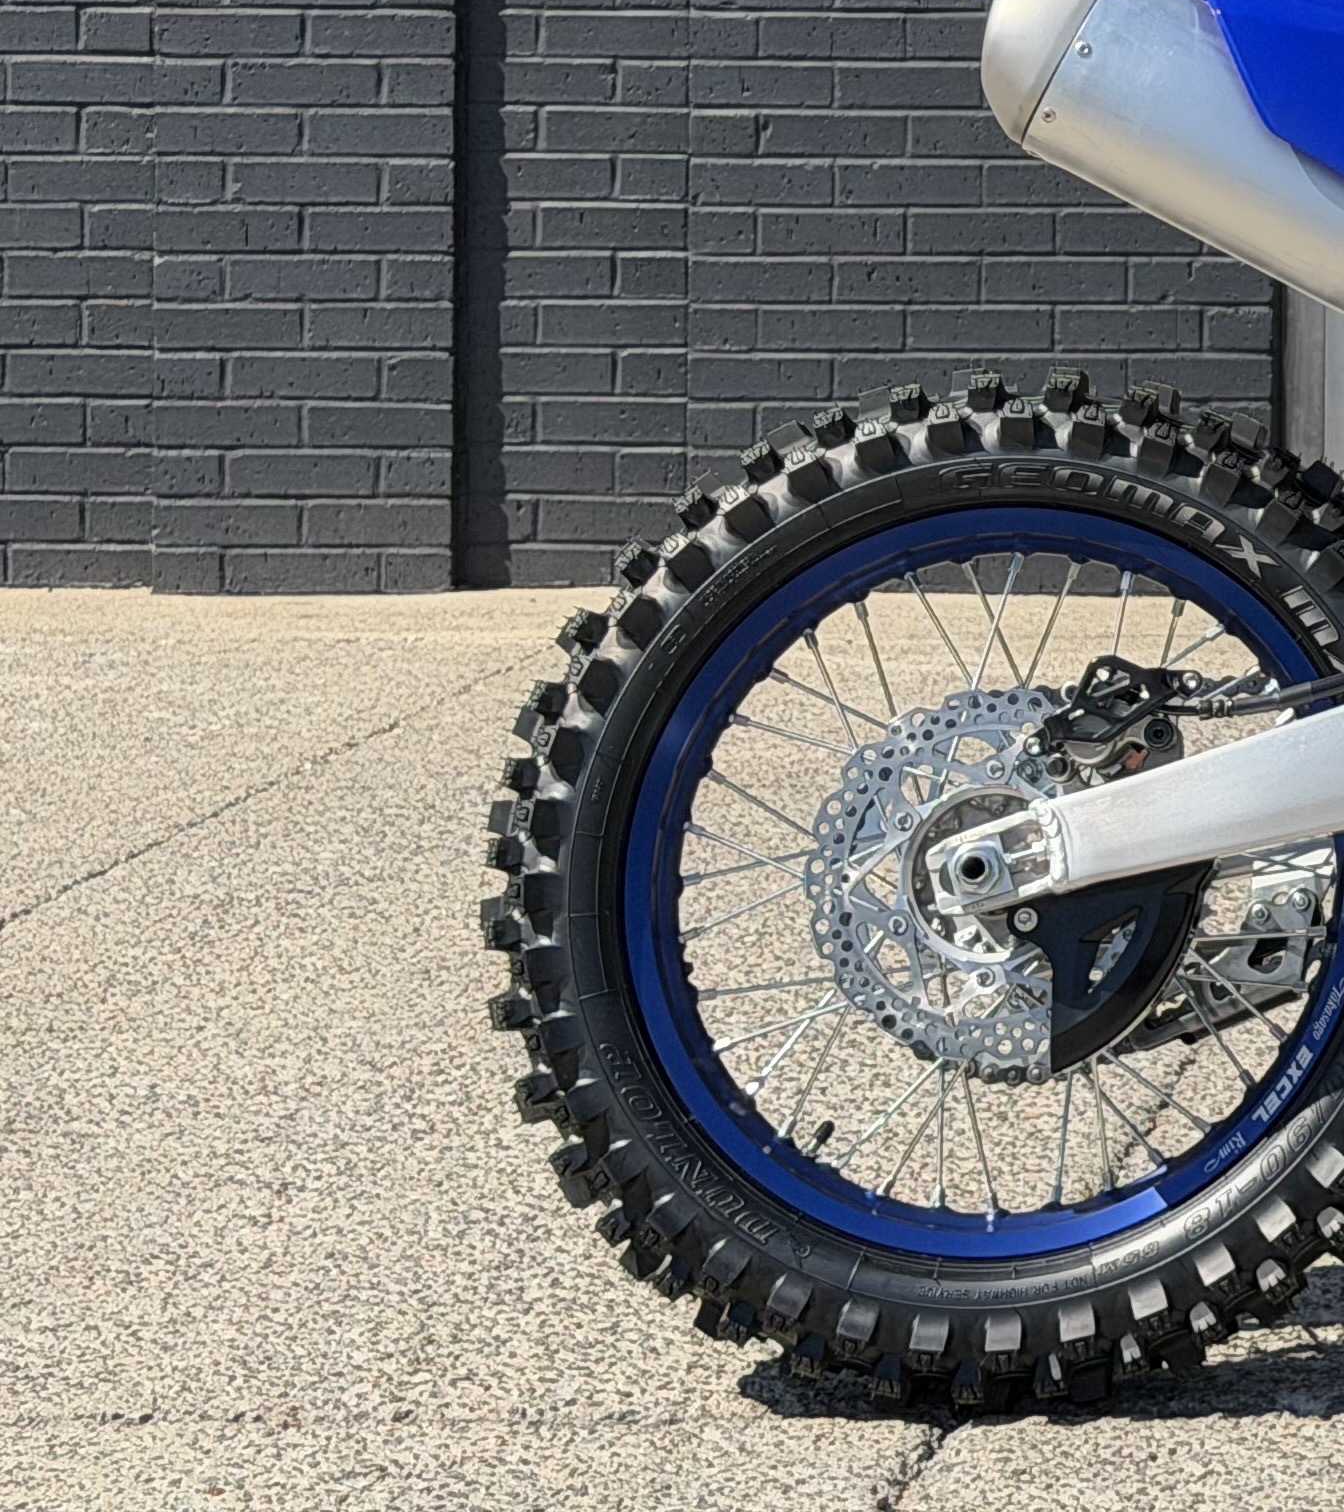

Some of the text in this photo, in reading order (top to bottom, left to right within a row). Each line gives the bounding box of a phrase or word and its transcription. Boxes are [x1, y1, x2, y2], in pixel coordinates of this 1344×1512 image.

[937, 461, 1280, 583] GEOMAX
[1252, 1048, 1314, 1123] EXCEL
[595, 1034, 788, 1255] DUNLOP
[1212, 1130, 1247, 1167] Rim
